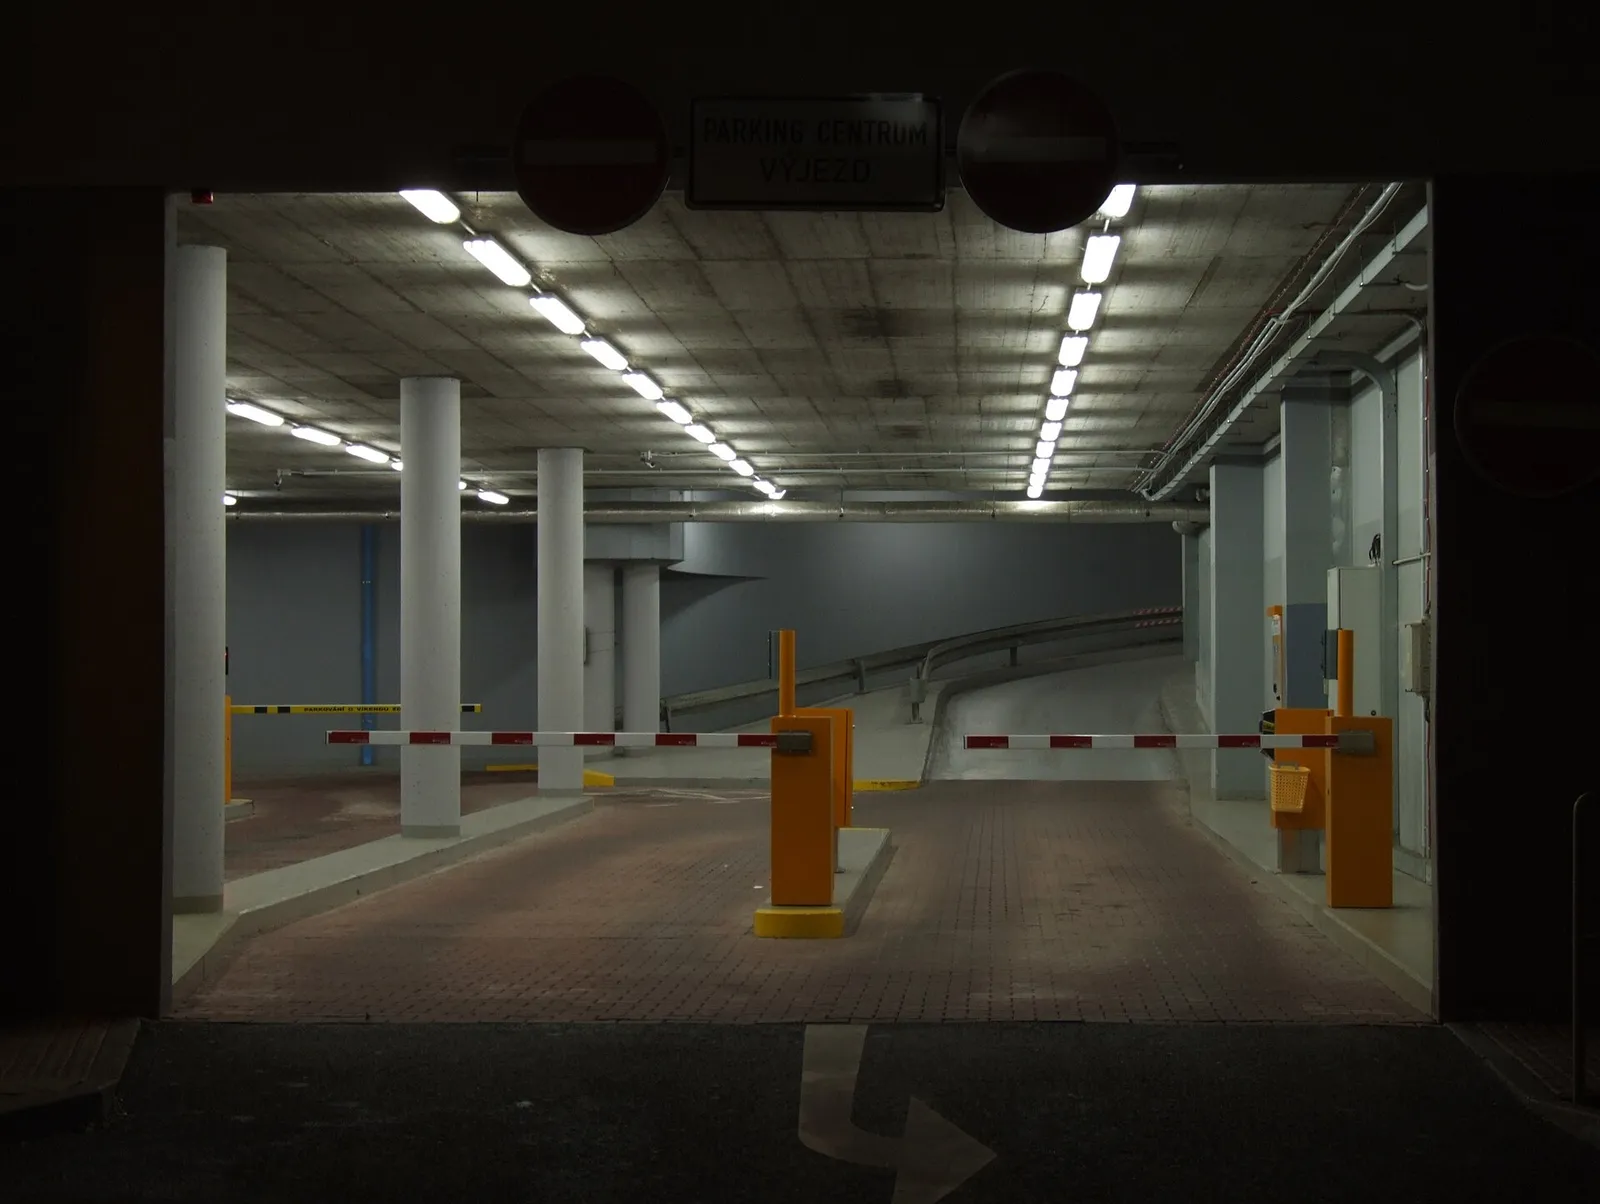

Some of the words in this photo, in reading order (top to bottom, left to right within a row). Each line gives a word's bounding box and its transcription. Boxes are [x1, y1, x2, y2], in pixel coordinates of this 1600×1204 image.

[704, 117, 804, 144] PARKING
[817, 119, 928, 146] CENTRUM
[760, 149, 871, 183] VÝJEZD
